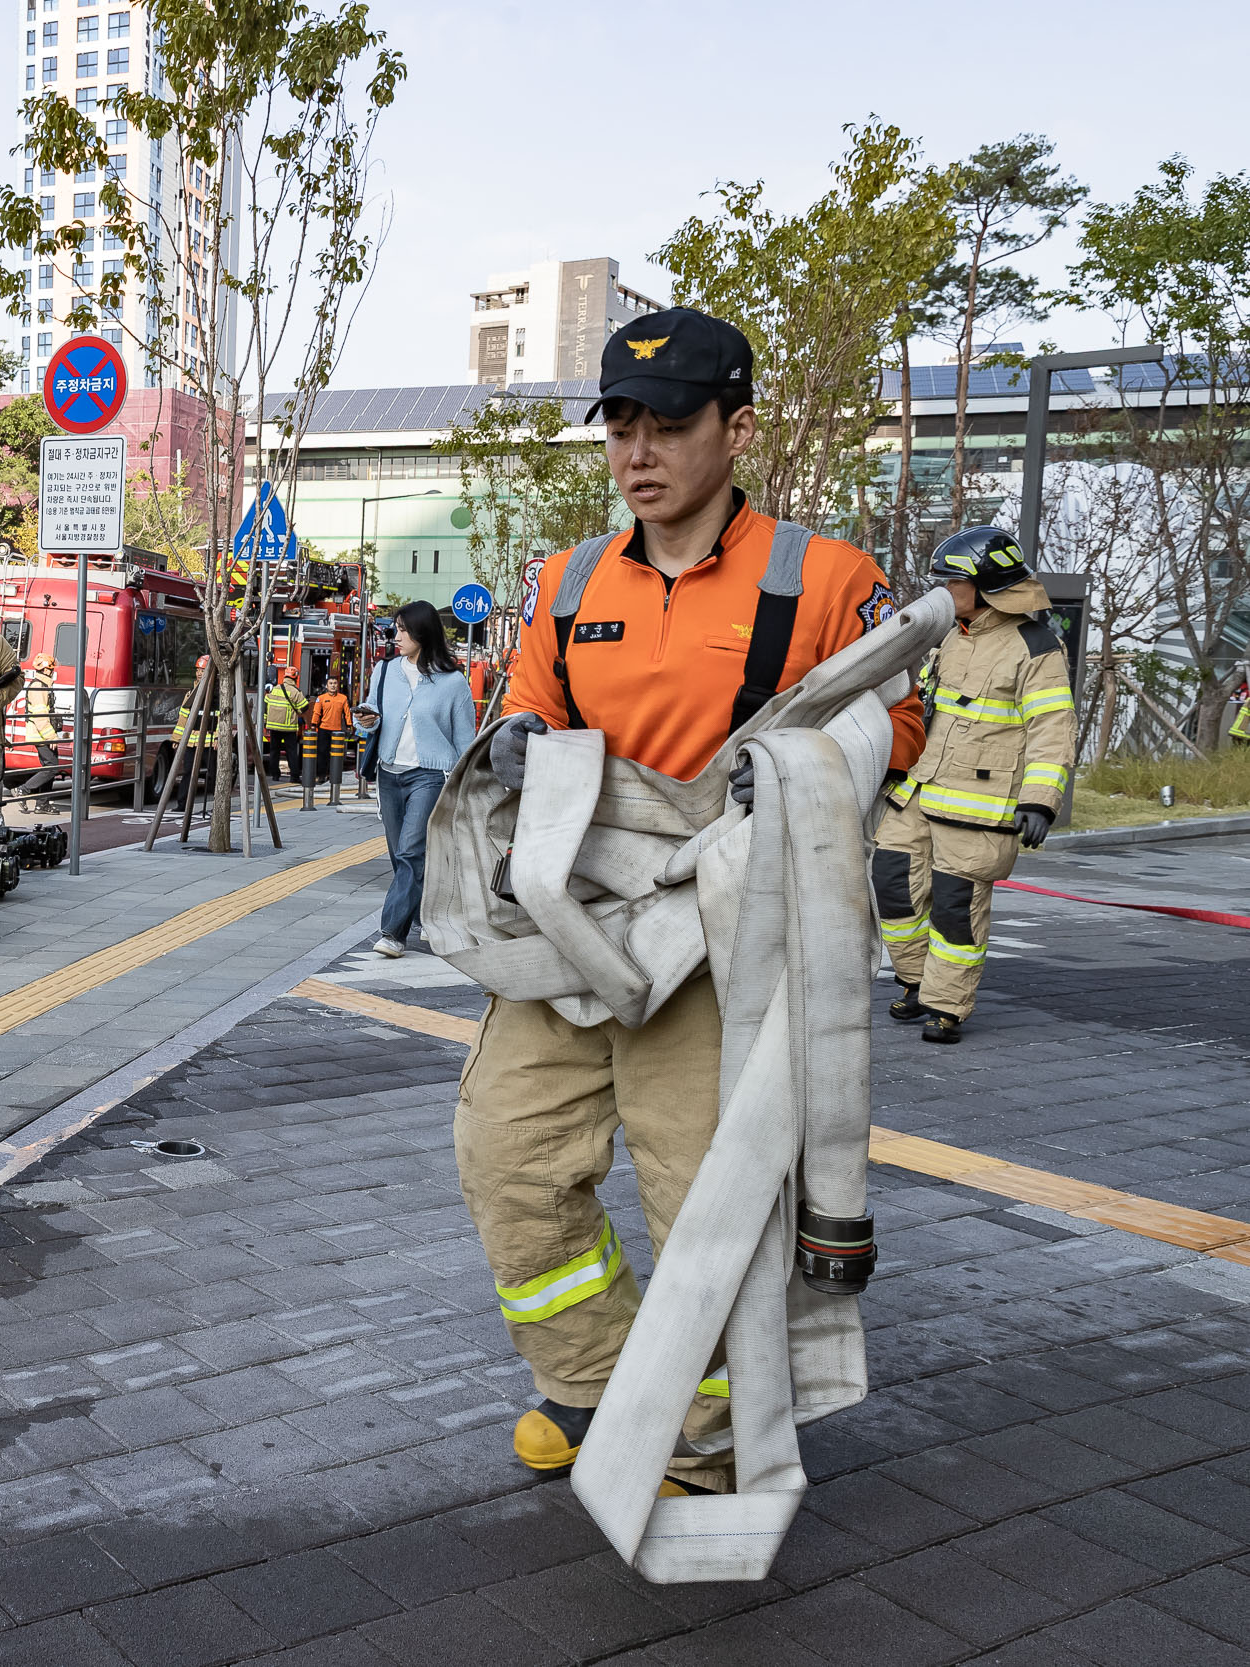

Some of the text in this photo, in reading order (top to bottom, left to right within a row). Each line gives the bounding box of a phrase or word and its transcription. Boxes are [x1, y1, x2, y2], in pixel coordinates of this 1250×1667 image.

[576, 294, 587, 332] TERRA
[574, 334, 586, 377] PALACE
[55, 376, 114, 393] 주정차금지
[48, 448, 62, 460] 절대
[66, 472, 86, 480] 24시간
[47, 483, 117, 493] 금지되는 구간으로 위반
[47, 496, 65, 504] 차량은
